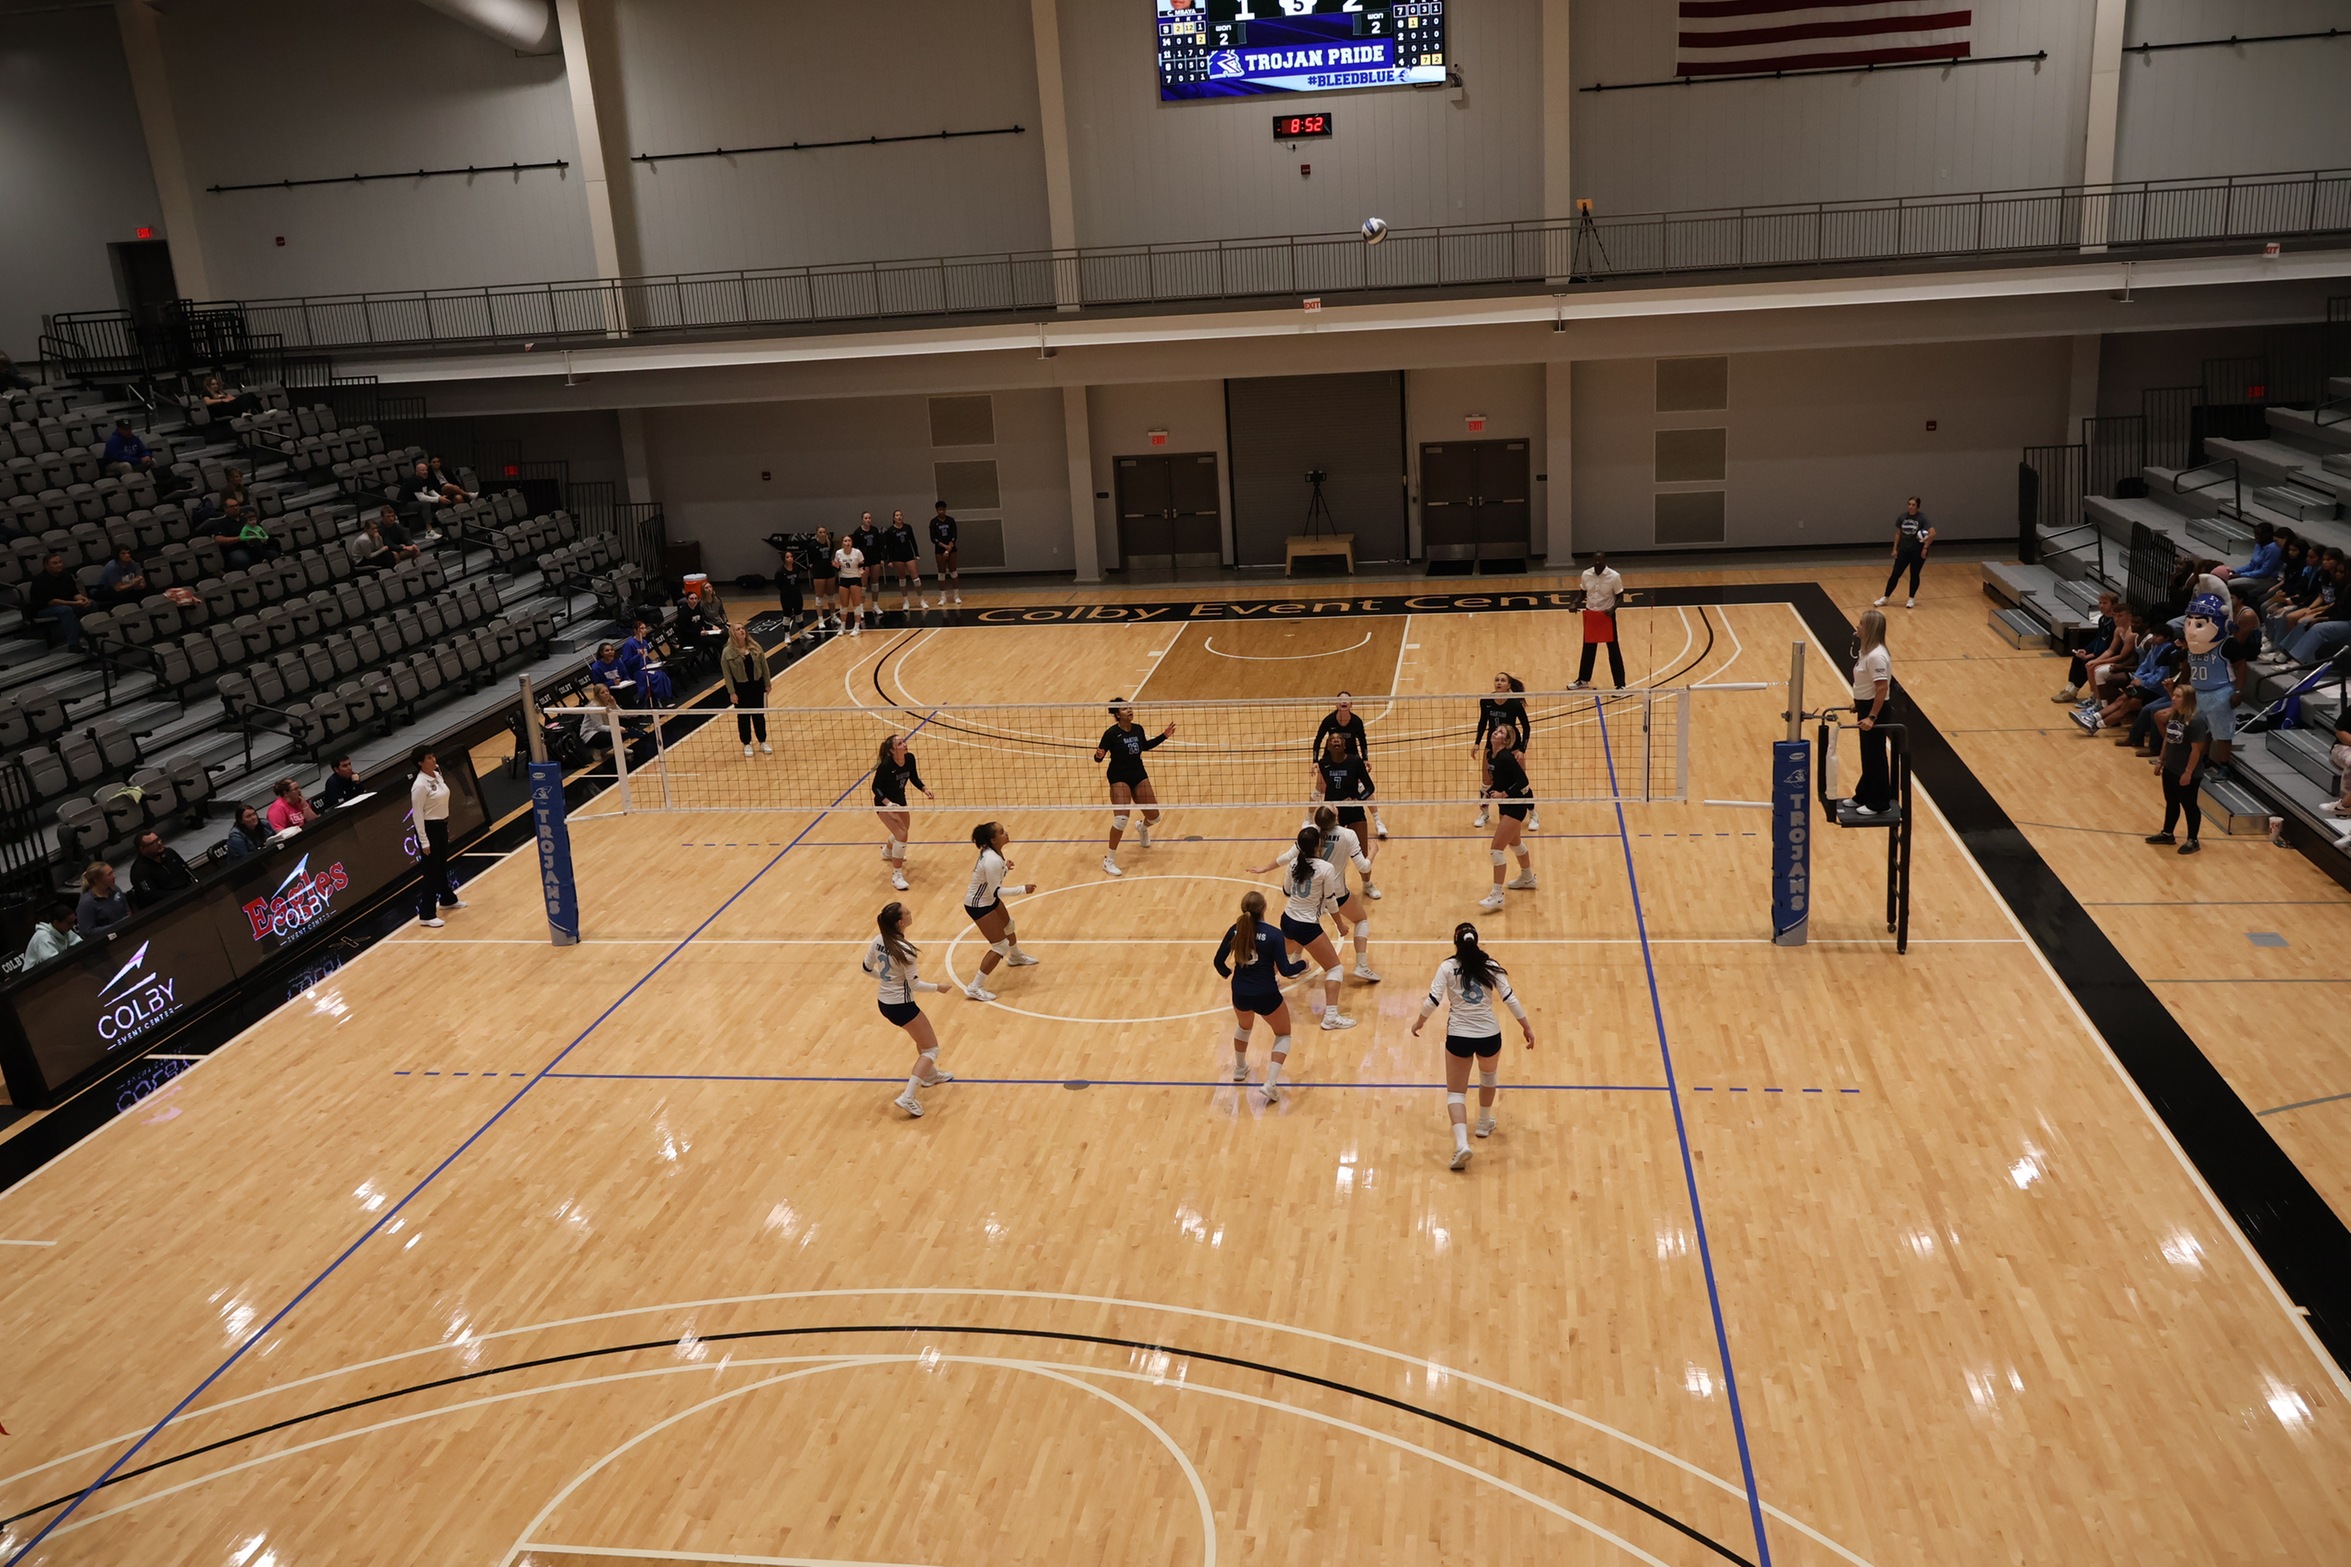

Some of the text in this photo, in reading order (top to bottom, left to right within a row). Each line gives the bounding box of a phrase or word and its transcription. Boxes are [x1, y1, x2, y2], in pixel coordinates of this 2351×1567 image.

[1219, 33, 1229, 46] 2
[1371, 21, 1381, 34] 2
[1245, 45, 1385, 71] TROJAN PRIDE
[1307, 70, 1395, 88] #BLEEDBLUE
[1291, 116, 1323, 133] 8:52
[1304, 301, 1320, 309] EXIT
[977, 591, 1645, 622] Colby Event Centr
[2191, 666, 2208, 680] 20
[1333, 776, 1342, 789] 7
[537, 808, 560, 915] TROJANS
[1788, 793, 1807, 912] TROJANS
[273, 887, 330, 936] COLBY
[878, 954, 892, 982] 2
[97, 977, 175, 1039] COLBY
[116, 1007, 175, 1046] EVENT CENTER
